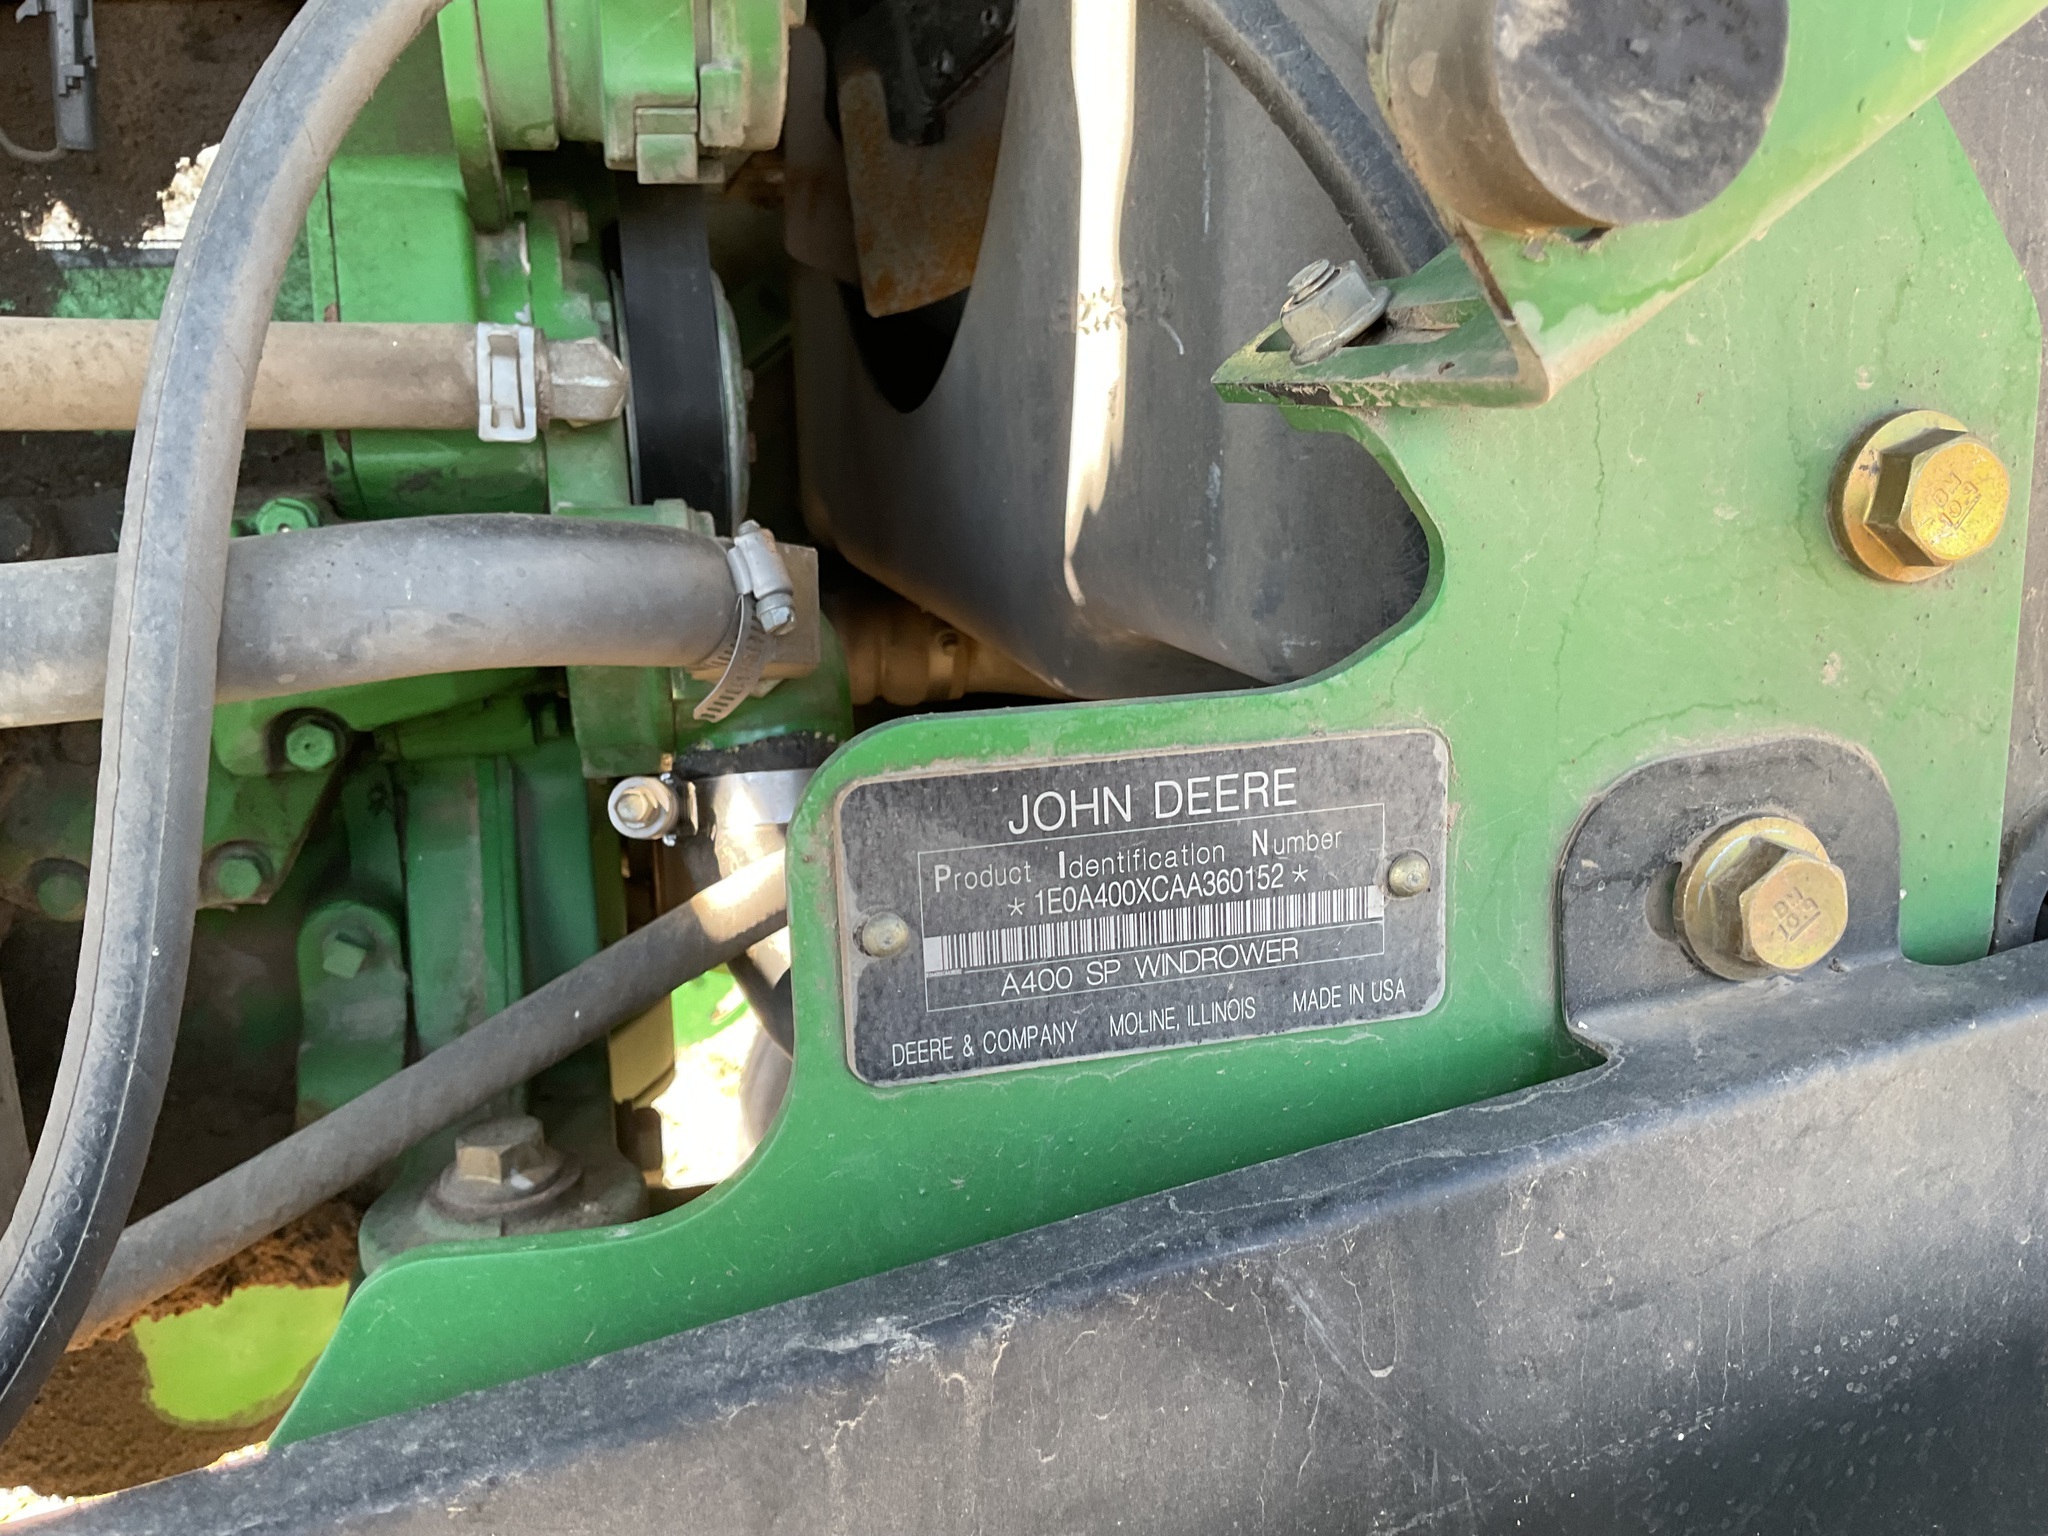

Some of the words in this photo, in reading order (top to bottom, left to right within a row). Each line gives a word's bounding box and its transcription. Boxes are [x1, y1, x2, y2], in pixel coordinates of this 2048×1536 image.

[1008, 784, 1132, 835] JOHN
[1154, 767, 1298, 819] DEERE
[934, 861, 1032, 893] Product
[1058, 842, 1226, 880] Identification
[1252, 828, 1343, 857] Number
[1001, 966, 1073, 997] A400
[1086, 959, 1121, 986] SP
[1134, 937, 1299, 980] WINDROWER
[892, 1036, 953, 1067] DEERE
[962, 1034, 974, 1057] &
[982, 1020, 1078, 1054] COMPANY
[1109, 1007, 1180, 1037] MOLINE,
[1187, 996, 1256, 1027] ILLINOIS
[1293, 985, 1342, 1013] MADE
[1349, 982, 1365, 1006] IN
[1371, 977, 1406, 1002] USA
